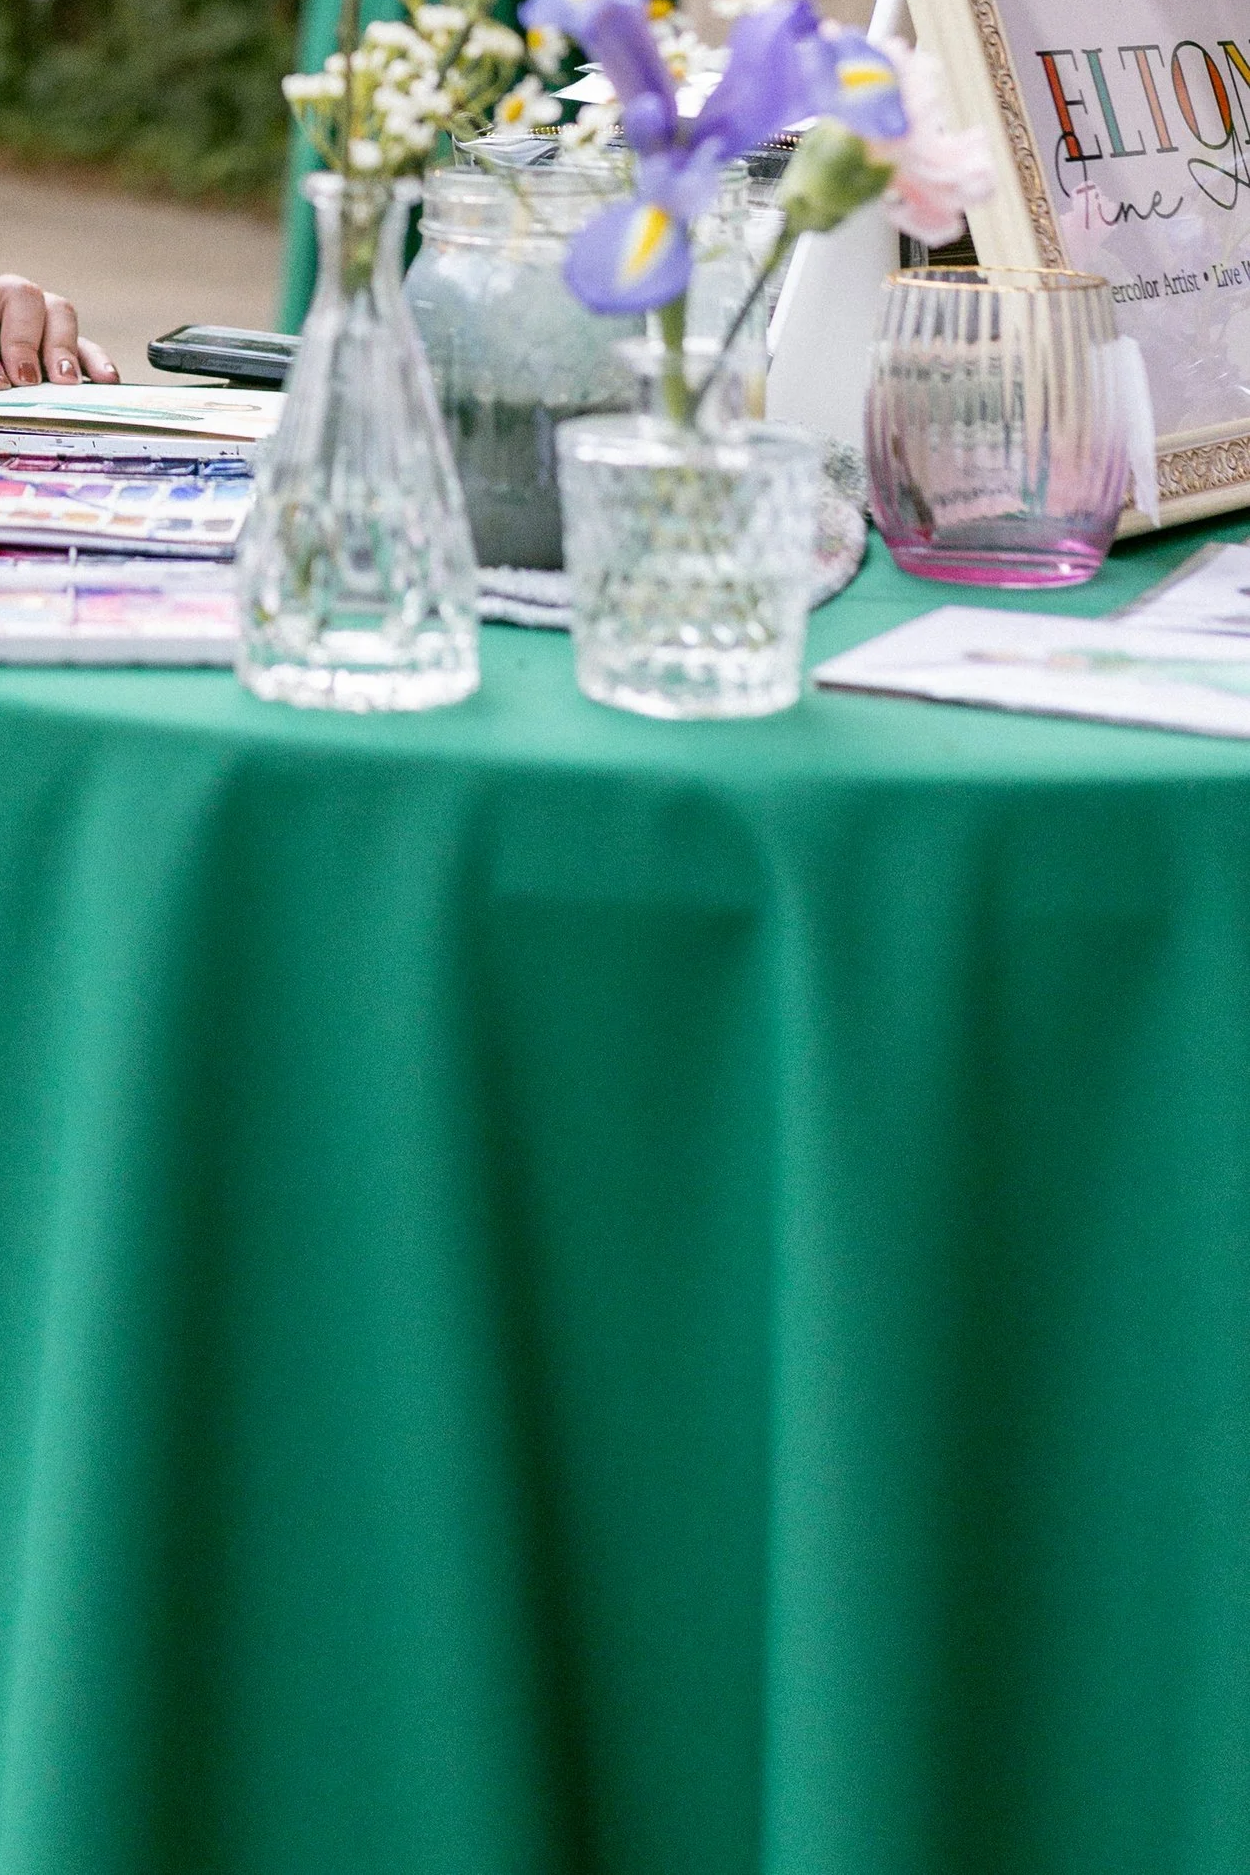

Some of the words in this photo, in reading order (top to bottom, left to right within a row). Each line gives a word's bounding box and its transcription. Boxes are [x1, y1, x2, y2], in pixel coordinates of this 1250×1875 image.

[1055, 131, 1184, 230] Fine
[1111, 274, 1161, 304] ercolor
[1163, 269, 1201, 296] Artist
[1212, 263, 1243, 288] Live
